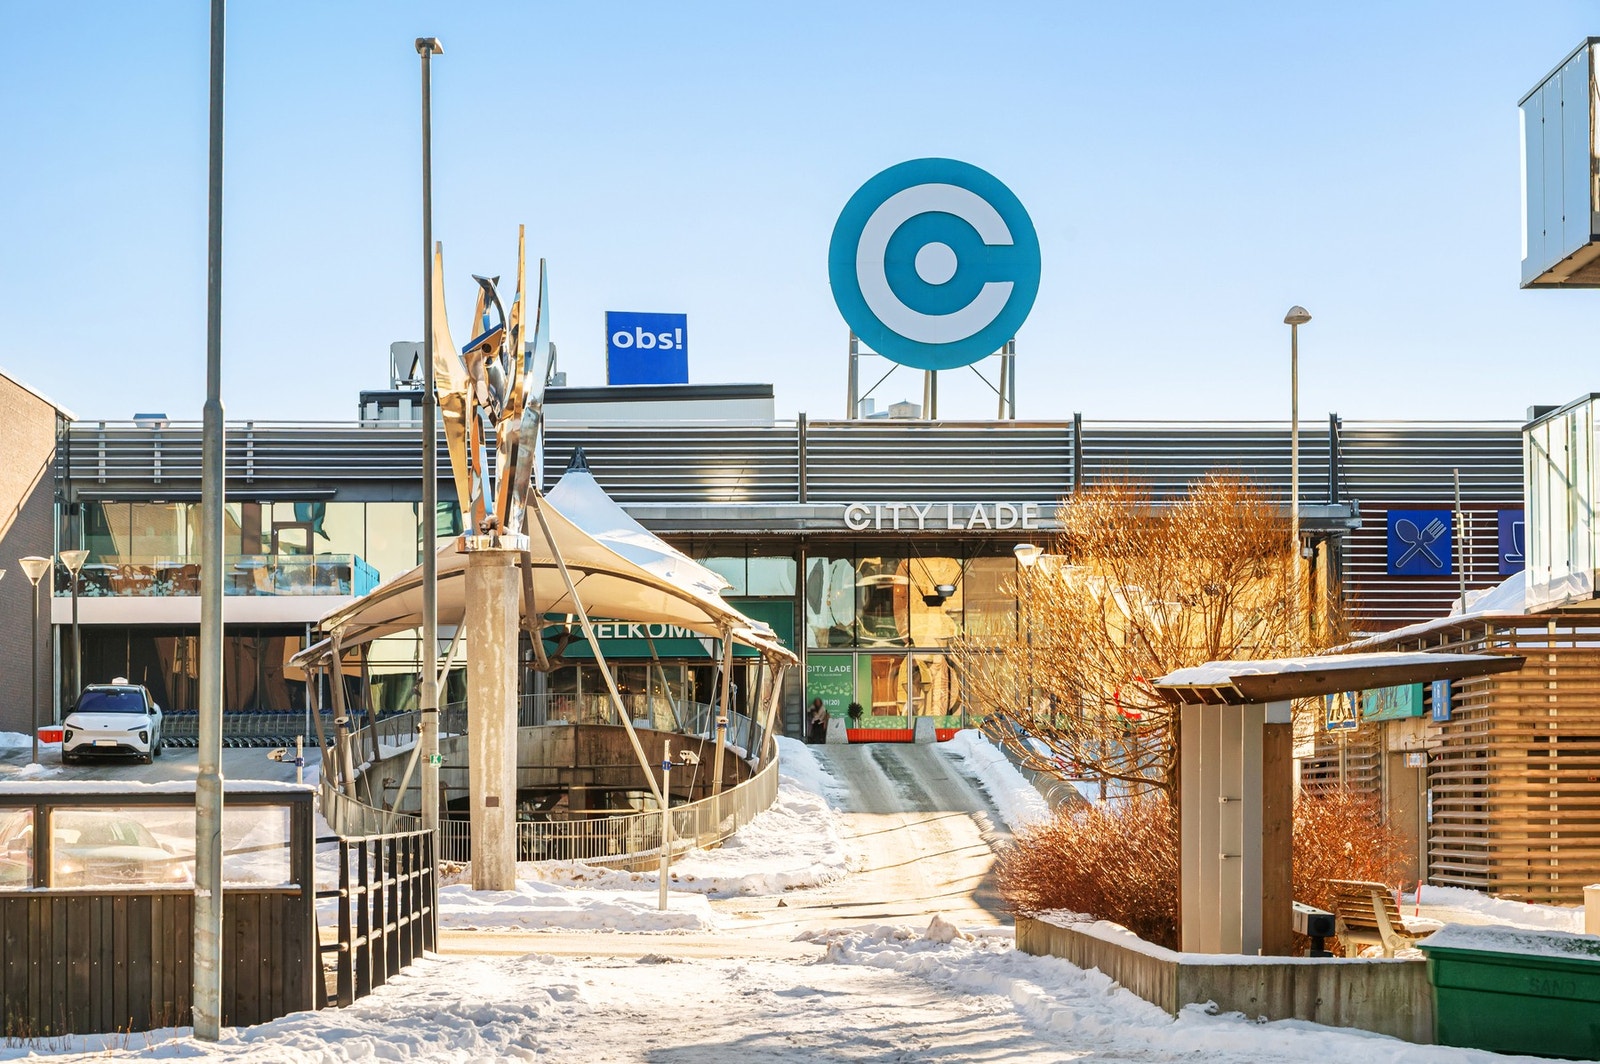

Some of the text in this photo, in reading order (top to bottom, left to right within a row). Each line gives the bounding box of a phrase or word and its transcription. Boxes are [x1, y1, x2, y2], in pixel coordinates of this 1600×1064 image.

[612, 326, 683, 350] obs!
[844, 502, 1039, 530] CITY LADE
[581, 619, 696, 638] VELKOM
[1529, 978, 1576, 996] SAND
